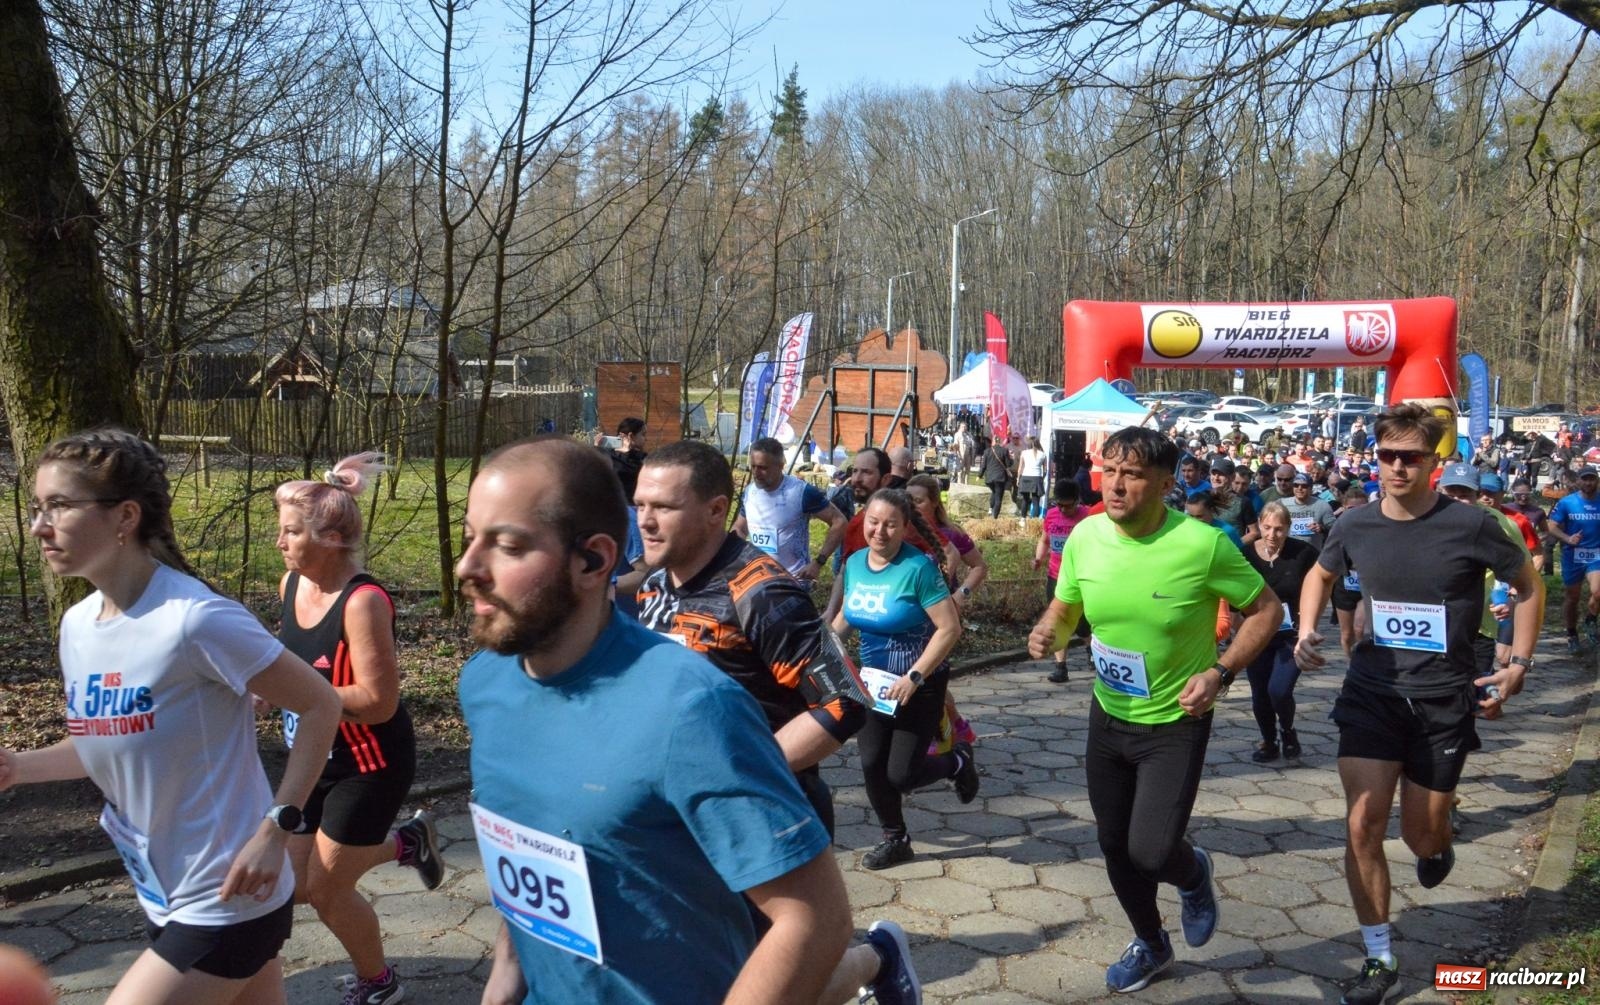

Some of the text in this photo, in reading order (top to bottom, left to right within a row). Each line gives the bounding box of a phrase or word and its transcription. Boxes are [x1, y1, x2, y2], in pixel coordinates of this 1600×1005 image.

[1248, 310, 1291, 321] BIEG
[1213, 327, 1330, 341] TWARDZIELA
[1223, 344, 1317, 359] RACIBÓRZ
[752, 533, 771, 545] 057
[1386, 617, 1432, 638] 092
[1098, 656, 1135, 684] 062
[497, 855, 570, 920] 095
